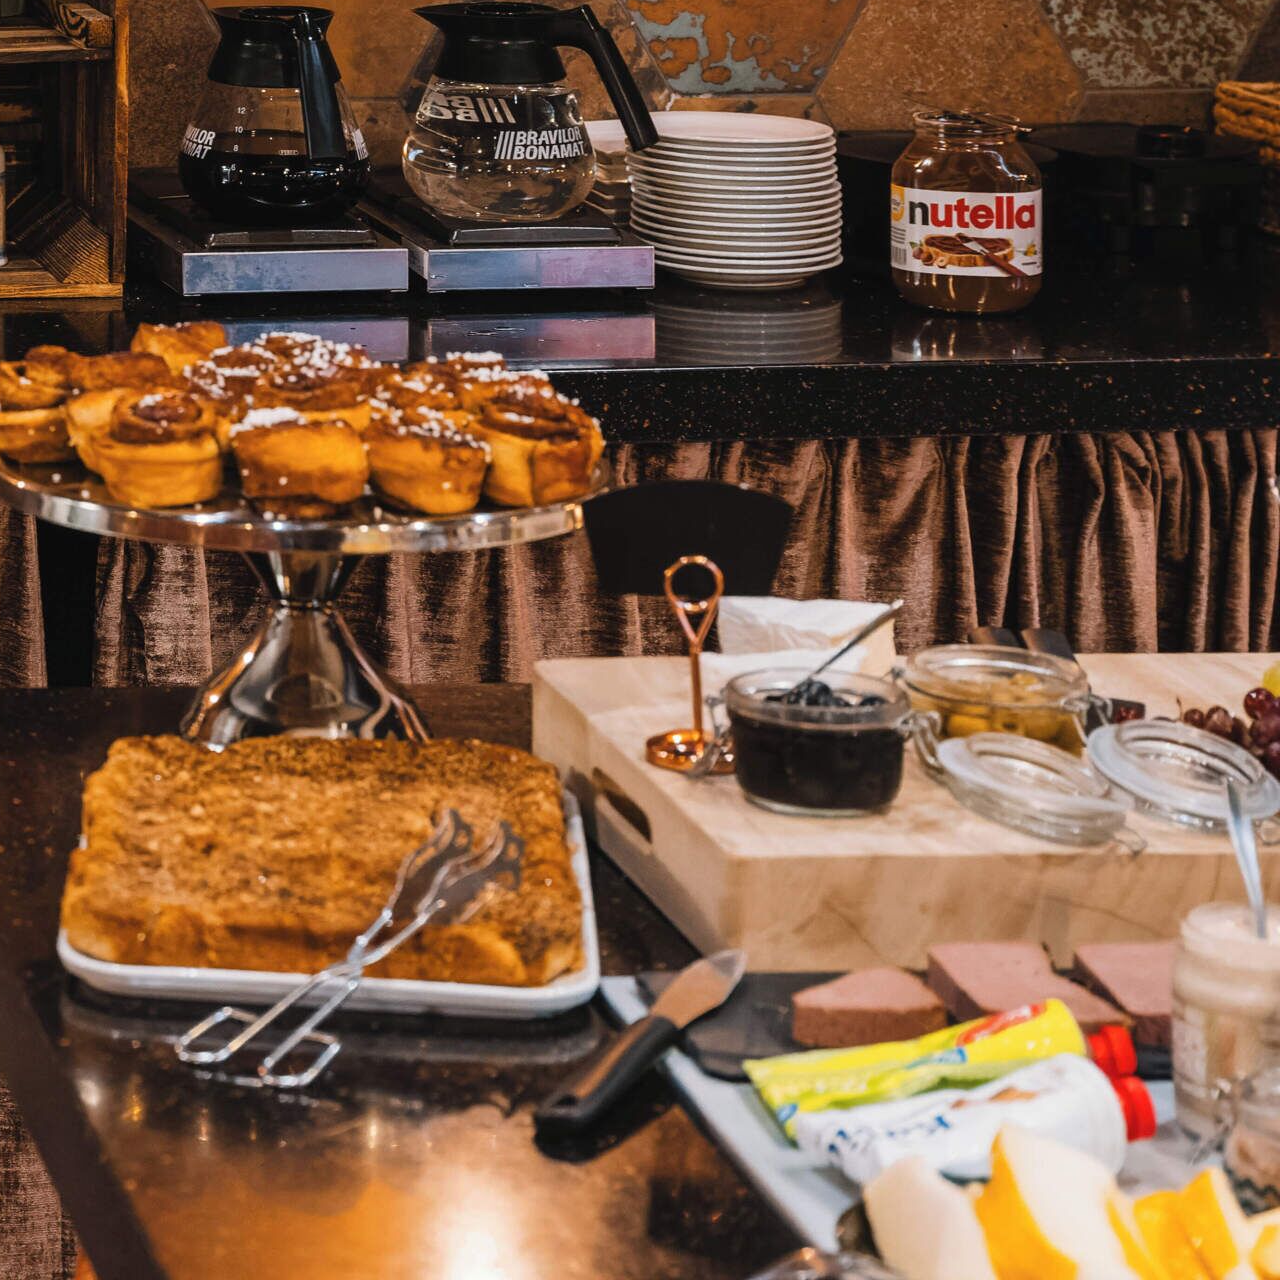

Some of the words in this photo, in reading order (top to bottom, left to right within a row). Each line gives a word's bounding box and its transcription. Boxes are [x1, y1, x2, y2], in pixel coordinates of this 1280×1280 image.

[237, 107, 247, 115] 12
[234, 126, 244, 134] 10
[515, 127, 583, 146] BRAVILOR
[233, 144, 239, 152] 8
[513, 141, 585, 160] BONAMAT
[909, 196, 1036, 230] nutella
